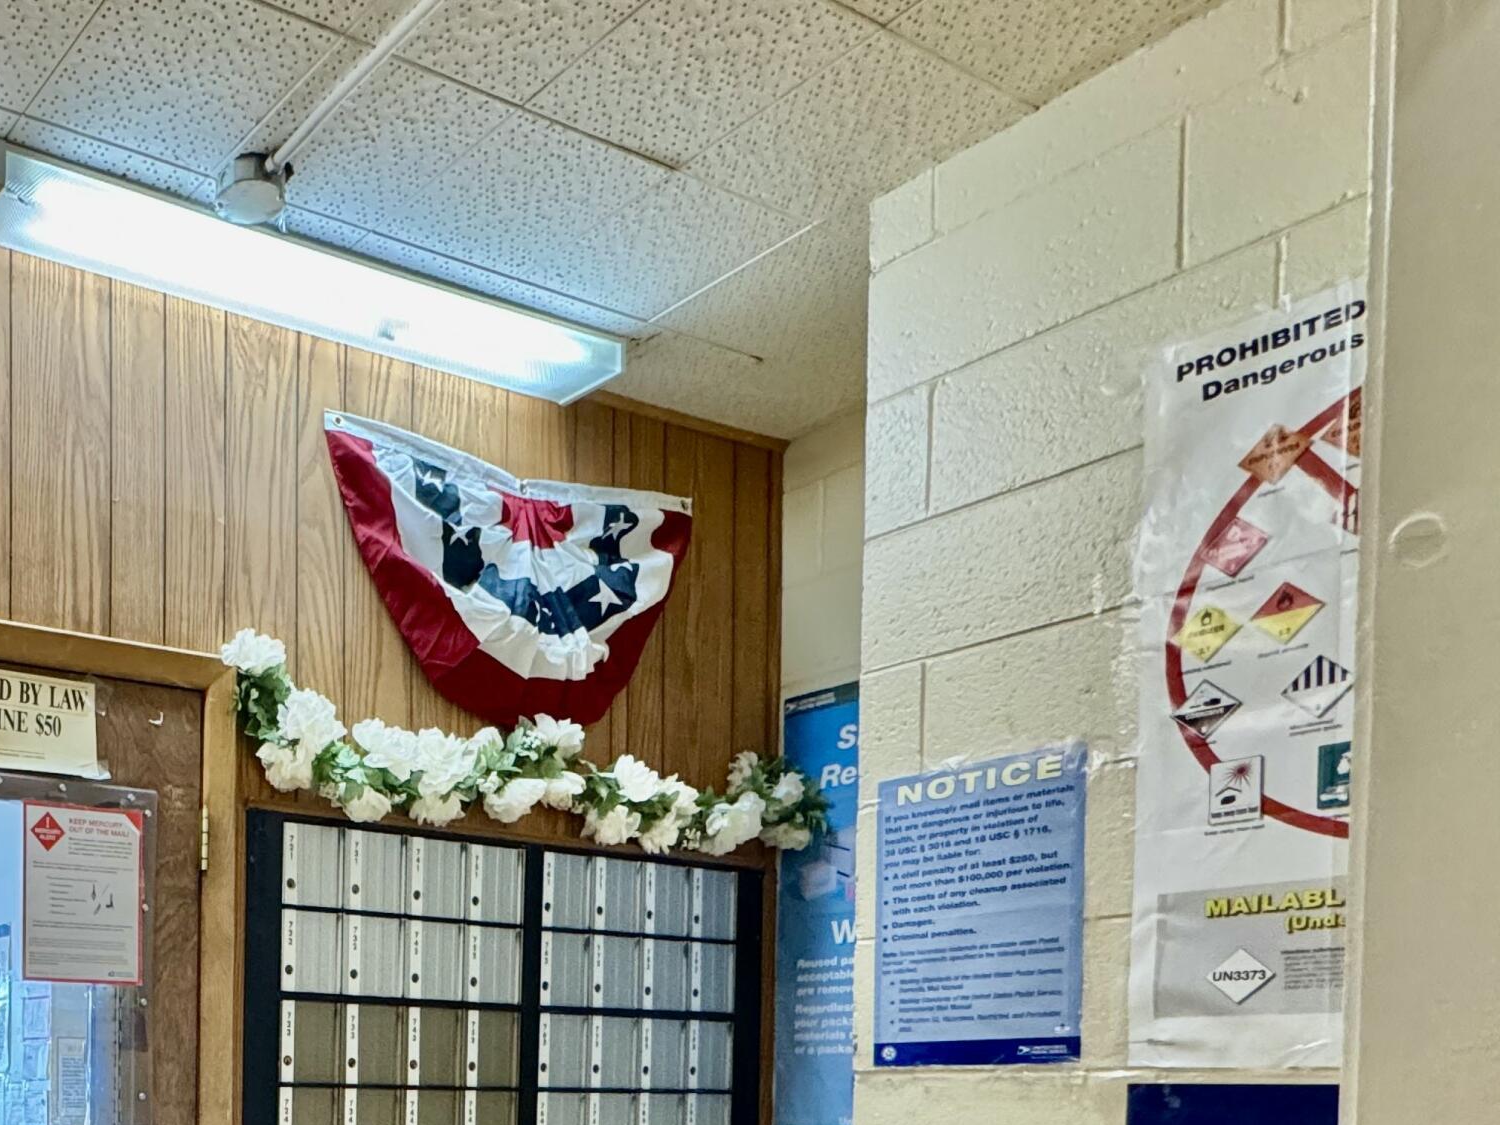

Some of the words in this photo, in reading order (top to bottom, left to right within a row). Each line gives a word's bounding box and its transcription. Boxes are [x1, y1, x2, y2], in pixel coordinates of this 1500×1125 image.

[1176, 300, 1365, 382] PROHIBITED
[1202, 334, 1364, 401] Dangerous
[19, 683, 42, 707] BY
[50, 687, 88, 712] LAW
[35, 711, 62, 737] $50
[897, 753, 1063, 806] NOTICE
[885, 815, 891, 823] If
[894, 812, 909, 823] you
[912, 804, 957, 818] knowingly
[960, 801, 980, 810] mail
[983, 797, 1010, 807] items
[1026, 785, 1075, 798] materials
[885, 825, 902, 834] that
[922, 816, 970, 829] dangerous
[986, 805, 1028, 818] injurious
[1045, 799, 1065, 808] life,
[958, 871, 1003, 883] $100,000
[892, 932, 928, 942] Criminal
[931, 928, 977, 938] penalties.
[1213, 971, 1266, 982] UN3373
